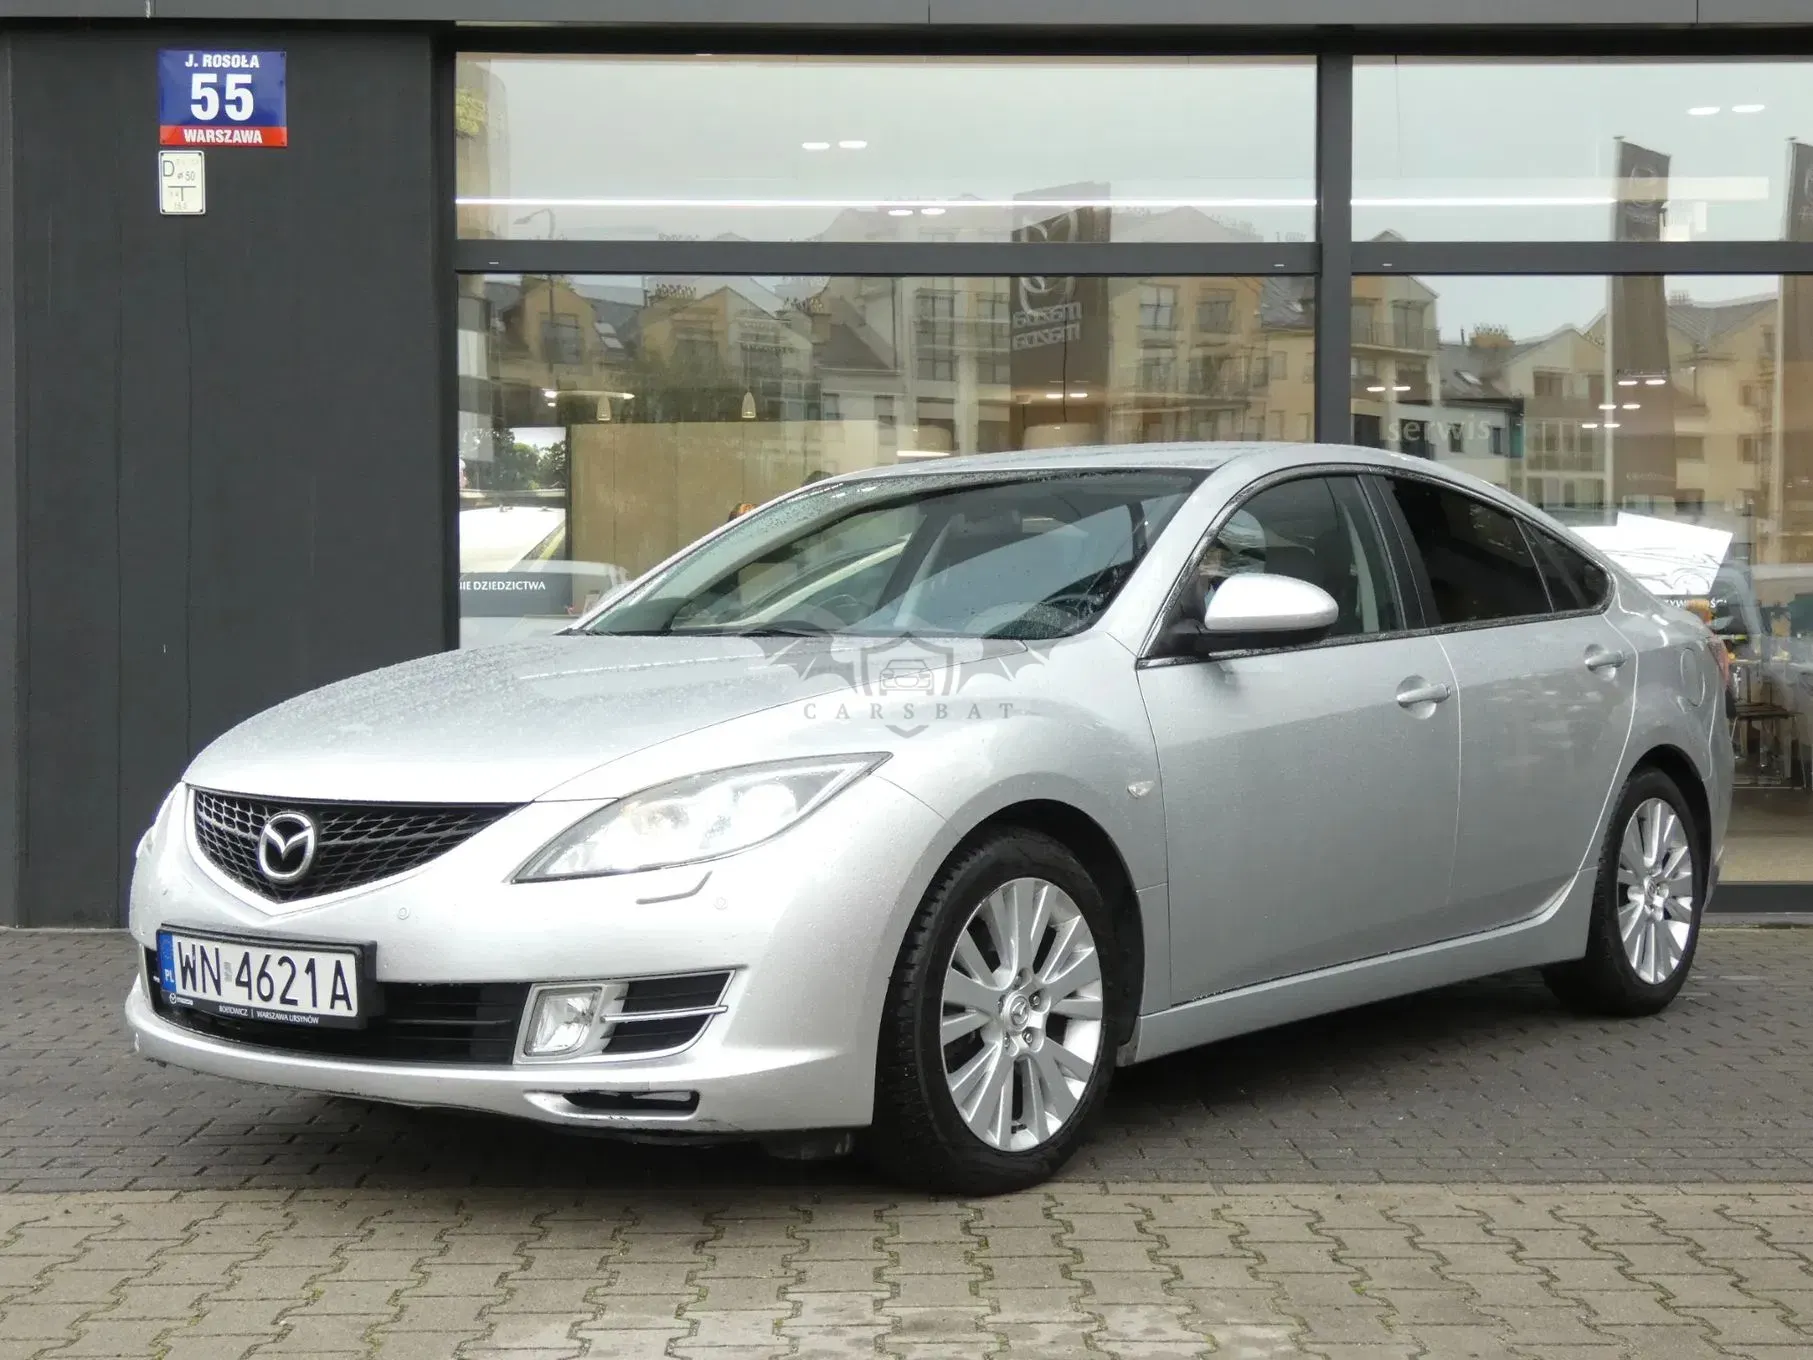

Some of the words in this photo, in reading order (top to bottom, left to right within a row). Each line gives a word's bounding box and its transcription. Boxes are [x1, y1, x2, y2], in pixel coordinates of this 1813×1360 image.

[185, 54, 198, 67] J.
[203, 54, 260, 68] ROSOŁA
[191, 73, 254, 121] 55
[184, 129, 262, 144] WARSZAWA
[163, 160, 175, 177] D
[1388, 413, 1490, 441] serwis
[473, 581, 546, 590] DZIEDZICTWA
[165, 969, 175, 982] PL
[178, 941, 221, 996] WN
[235, 951, 352, 1011] 4621A
[256, 1010, 288, 1021] WARSZAWA
